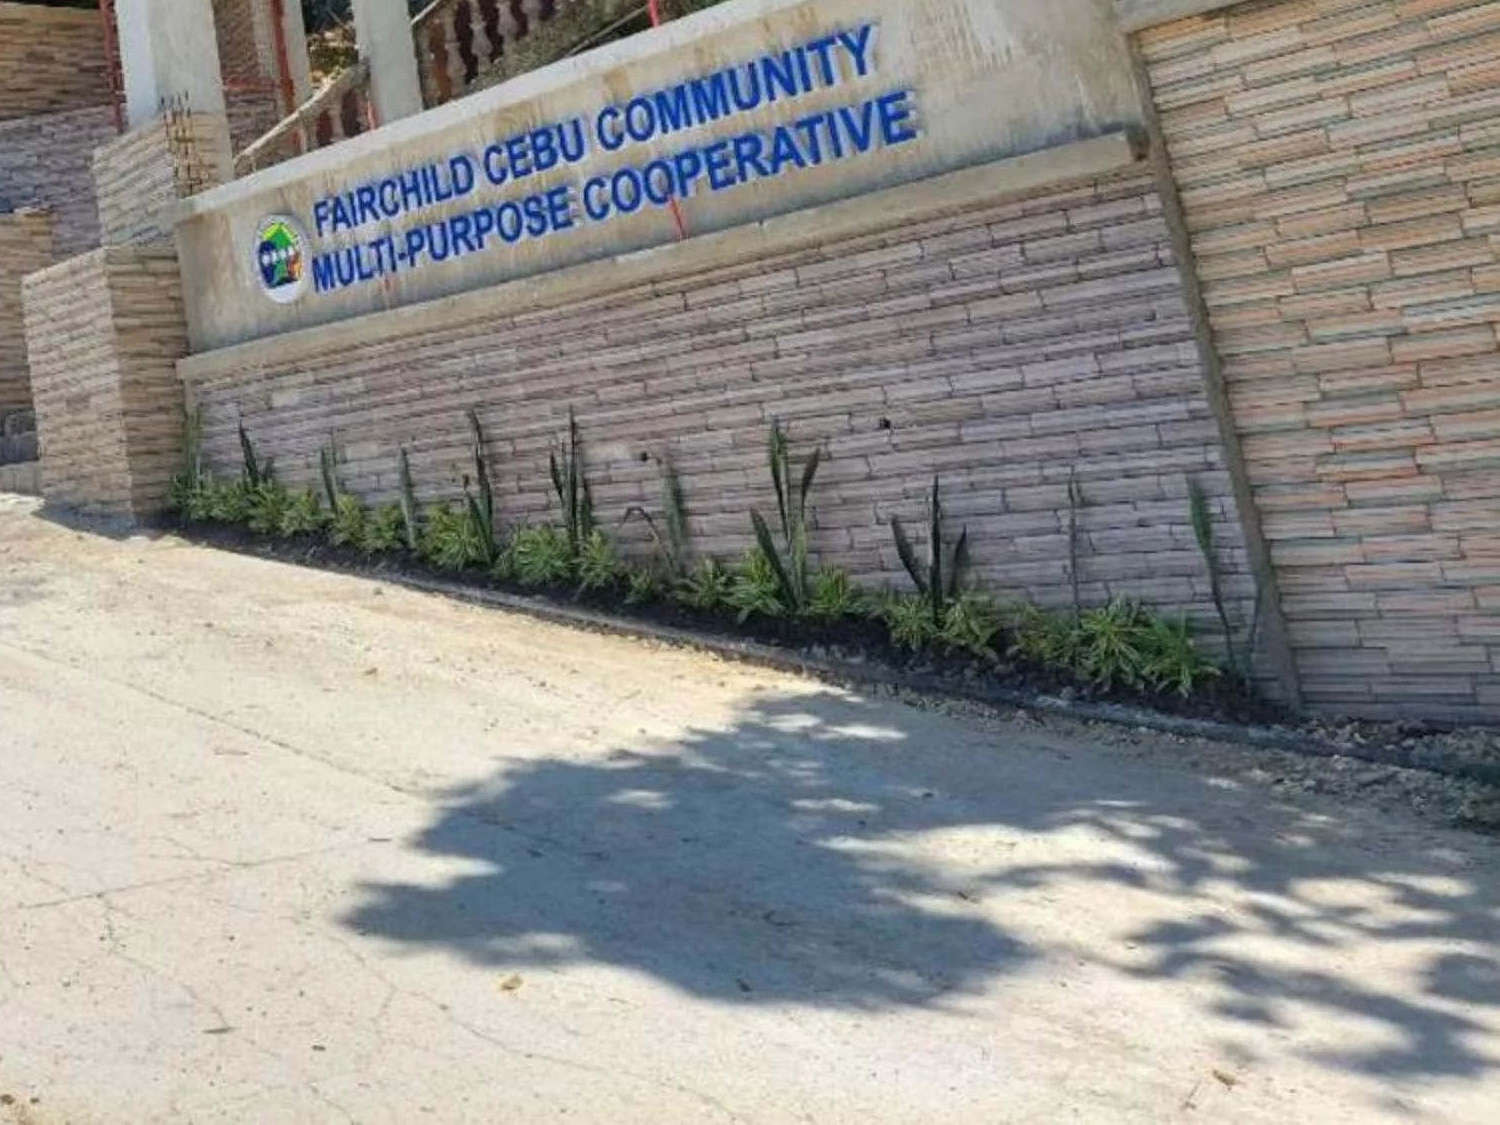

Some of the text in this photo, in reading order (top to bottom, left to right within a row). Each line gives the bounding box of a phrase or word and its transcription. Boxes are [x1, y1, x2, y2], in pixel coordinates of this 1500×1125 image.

[311, 186, 574, 293] MULTI-PURPOSE
[583, 91, 917, 220] COOPERATIVE
[313, 25, 874, 237] FAIRCHILD CEBU COMMUNITY
